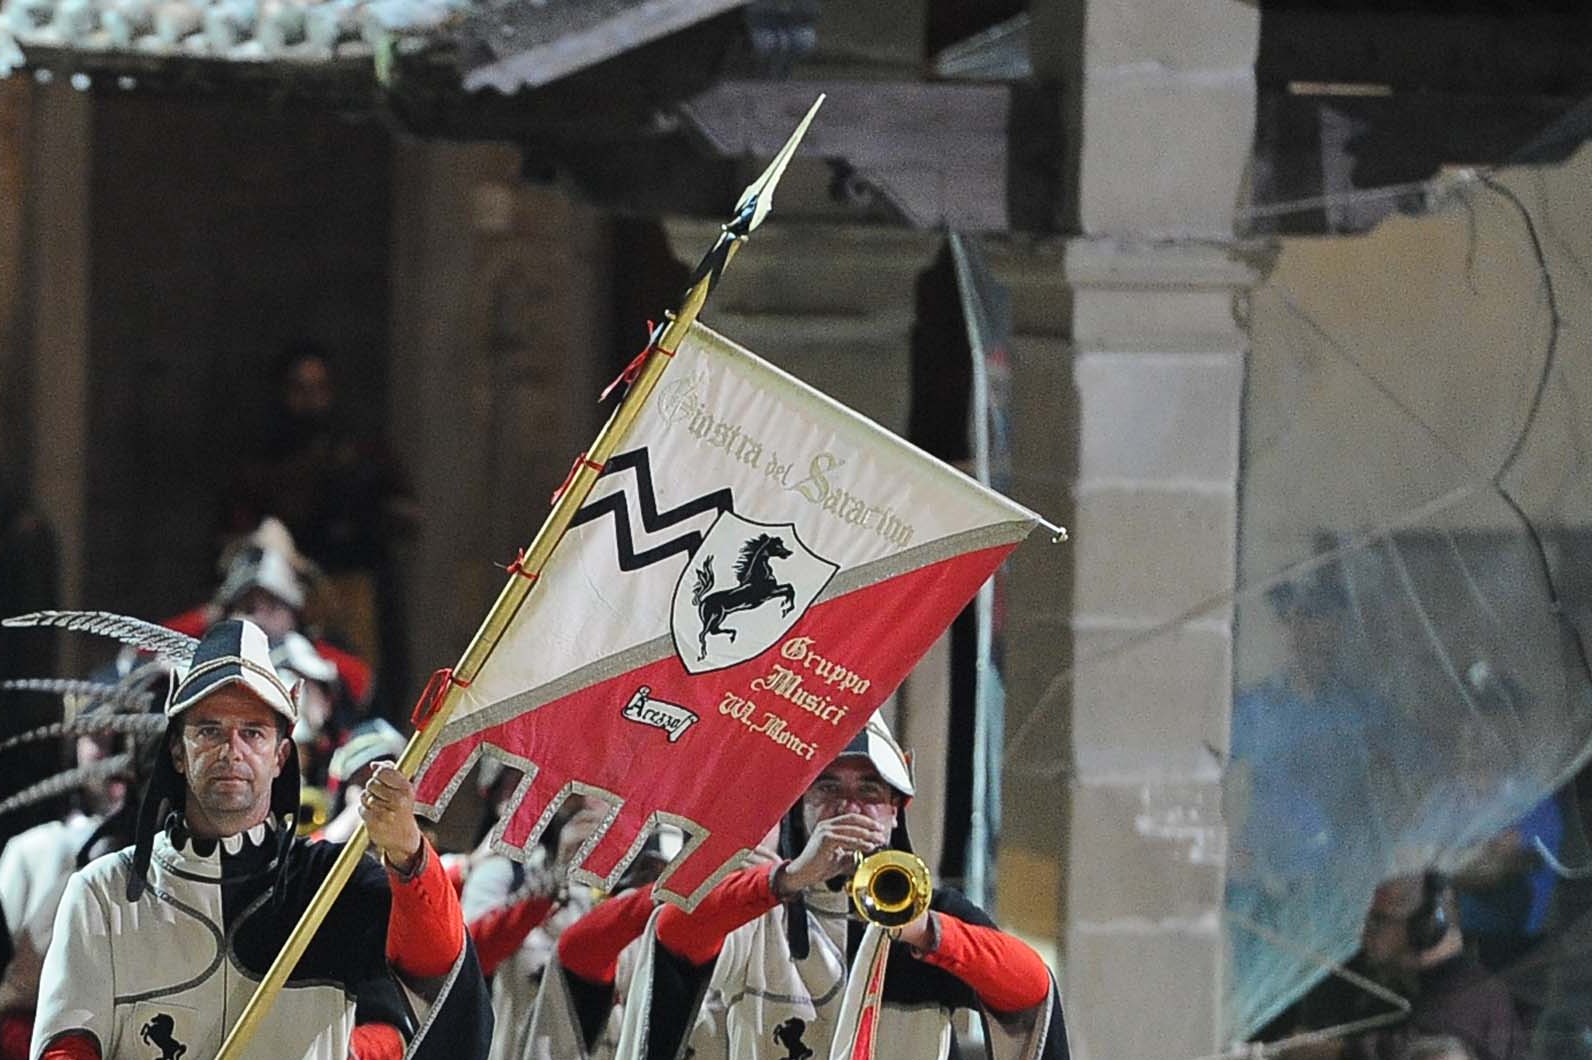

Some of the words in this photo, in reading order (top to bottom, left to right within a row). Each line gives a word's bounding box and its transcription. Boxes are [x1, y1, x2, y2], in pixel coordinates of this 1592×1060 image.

[765, 452, 793, 486] del
[784, 451, 914, 546] Saracino
[750, 664, 849, 725] Musici
[781, 636, 871, 694] Gruppo
